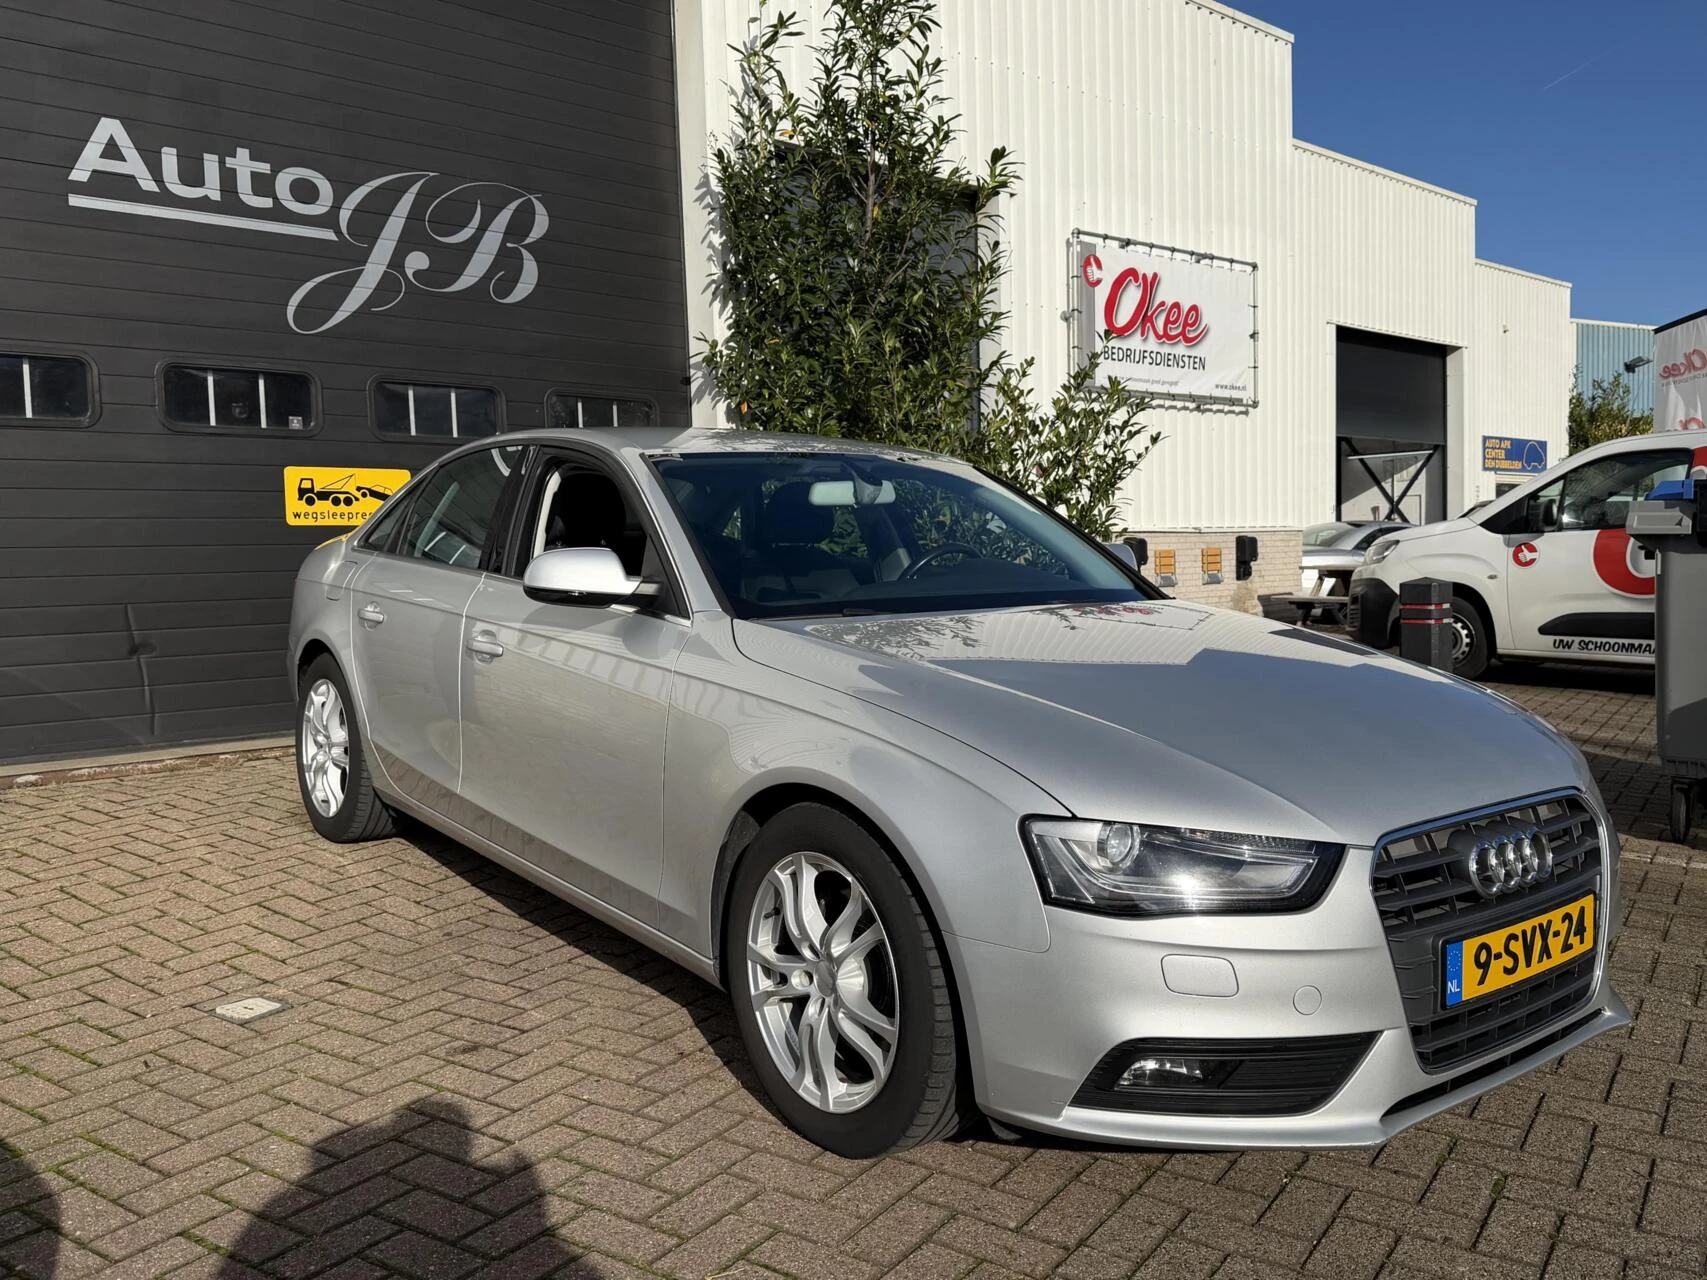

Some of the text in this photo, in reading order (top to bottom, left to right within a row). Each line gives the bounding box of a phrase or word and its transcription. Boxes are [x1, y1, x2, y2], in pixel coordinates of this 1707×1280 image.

[68, 117, 334, 215] Auto
[1104, 267, 1209, 345] Okee
[1103, 345, 1206, 371] BEDRIJFSDIENSTEN
[1485, 439, 1511, 449] AUTO APK
[1485, 449, 1505, 459] CENTER
[1553, 639, 1656, 655] UW SCHOONMA
[1474, 905, 1587, 987] 9-SVX-24
[1447, 980, 1460, 993] NL
